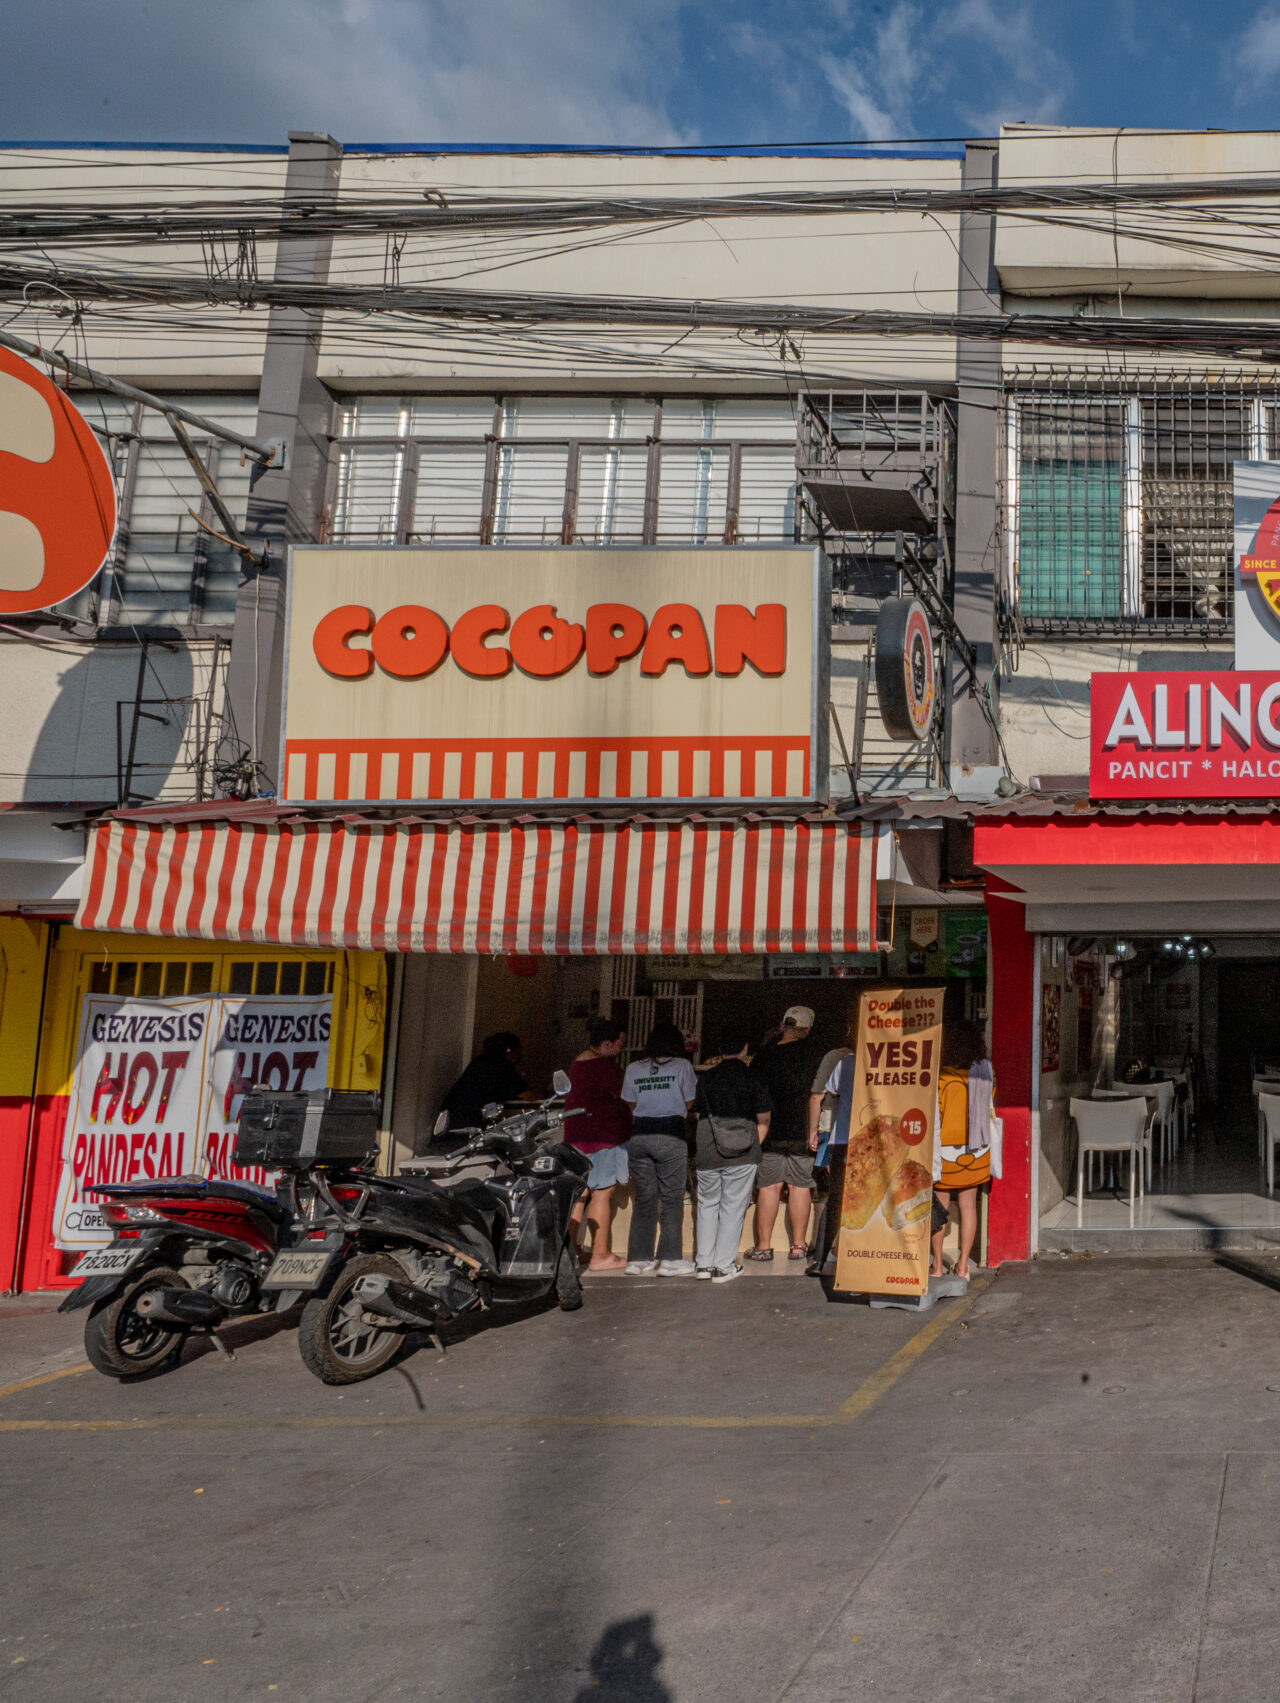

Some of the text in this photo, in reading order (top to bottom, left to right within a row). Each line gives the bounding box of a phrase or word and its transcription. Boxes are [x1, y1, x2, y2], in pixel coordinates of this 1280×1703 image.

[1244, 559, 1277, 569] SINCE
[313, 603, 787, 680] COCOPAN
[1109, 761, 1192, 780] PANCIT
[868, 996, 935, 1012] Double the
[92, 1012, 205, 1043] GENESIS
[225, 1013, 331, 1044] GENESIS
[867, 1013, 935, 1029] Cheese?!?
[89, 1051, 190, 1126] HOT
[634, 1076, 675, 1085] UNIVERSITY
[639, 1085, 652, 1093] JOB
[77, 1254, 134, 1271] 782QCX
[847, 1249, 920, 1260] DOUBLE CHEESE ROLL
[273, 1258, 323, 1275] 709NCF
[886, 1276, 920, 1285] COCOPAN
